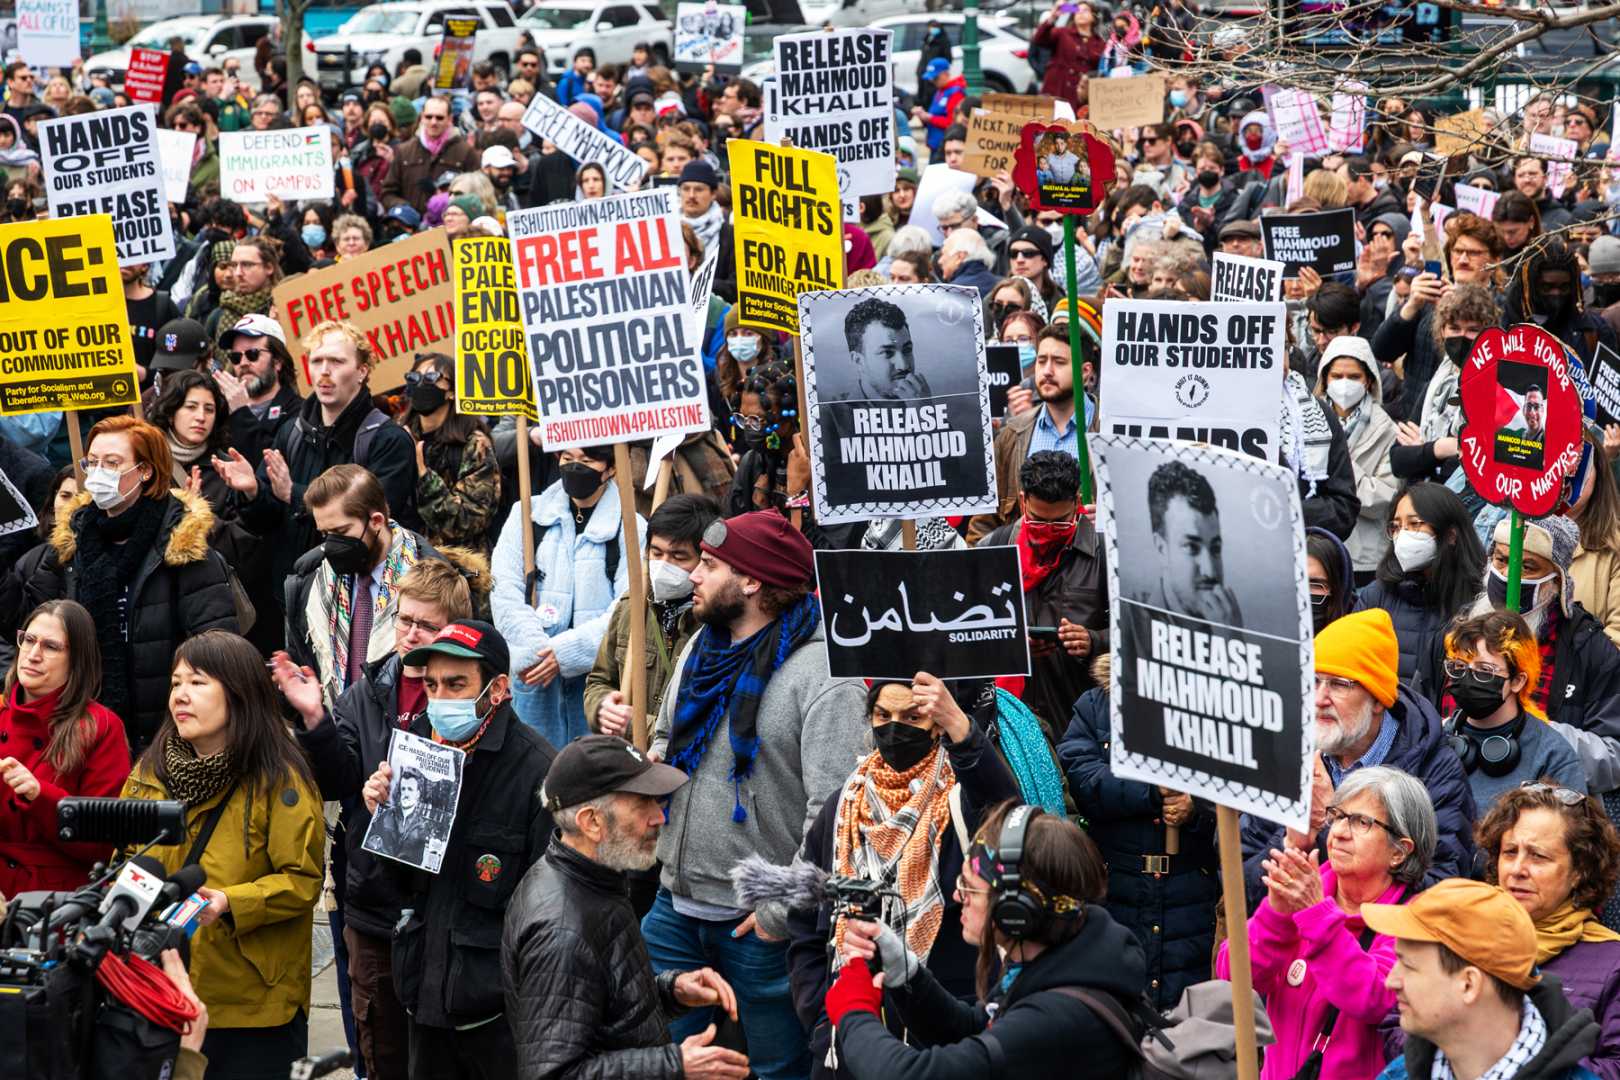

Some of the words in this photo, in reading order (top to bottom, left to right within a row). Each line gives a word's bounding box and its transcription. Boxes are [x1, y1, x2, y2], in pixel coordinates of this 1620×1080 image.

[780, 34, 888, 72] RELEASE
[781, 65, 887, 98] MAHMOUD
[782, 92, 888, 117] KHALIL
[46, 111, 150, 156] HANDS
[243, 133, 303, 150] DEFEND
[524, 96, 574, 144] FREE
[564, 124, 643, 186] MAHMOUD
[785, 121, 852, 149] HANDS
[858, 116, 889, 142] OFF
[53, 143, 150, 172] OFF
[226, 151, 326, 171] IMMIGRANTS
[754, 148, 817, 196] FULL
[983, 155, 1009, 170] FOR
[53, 173, 83, 191] OUR
[87, 161, 156, 186] STUDENTS
[232, 178, 255, 193] ON
[265, 173, 321, 191] CAMPUS
[513, 192, 672, 237] #SHUTITDOWN4PALESTINE
[739, 183, 834, 236] RIGHTS
[113, 216, 163, 244] MOUD
[1270, 226, 1300, 238] FREE
[1272, 234, 1340, 250] MAHMOUD
[116, 239, 167, 259] LIL
[460, 241, 514, 264] STAN
[516, 227, 604, 289] FREE
[615, 217, 681, 275] ALL
[743, 239, 787, 277] FOR
[794, 251, 837, 287] ALL
[1274, 250, 1318, 262] KHALIL
[286, 282, 350, 338] FREE
[351, 247, 450, 312] SPEECH
[461, 265, 516, 290] PALE
[745, 269, 830, 299] IMMIGRA
[1215, 259, 1276, 302] RELEASE
[462, 290, 520, 324] END
[523, 270, 686, 326] PALESTINIAN
[44, 328, 71, 350] OF
[82, 323, 121, 346] OUR
[461, 328, 526, 351] OCCUP
[1116, 311, 1218, 344] HANDS
[1227, 315, 1276, 345] OFF
[530, 313, 694, 377] POLITICAL
[1115, 343, 1159, 366] OUR
[1166, 345, 1273, 369] STUDENTS
[1, 348, 123, 375] COMMUNITIES!
[1471, 339, 1493, 370] WE
[1501, 331, 1525, 355] WILL
[1534, 335, 1570, 392] HONOR
[1599, 360, 1620, 388] FREE
[5, 387, 27, 397] Party
[28, 385, 39, 394] for
[41, 383, 77, 393] Socialism
[78, 381, 94, 390] and
[537, 359, 700, 417] PRISONERS
[987, 371, 1010, 385] OUD
[1594, 373, 1620, 406] MAHM
[7, 395, 48, 406] Liberation
[547, 404, 705, 445] #SHUTITDOWN4PALESTINE
[852, 403, 949, 435] RELEASE
[840, 430, 967, 464] MAHMOUD
[866, 461, 946, 491] KHALIL
[1463, 436, 1487, 477] ALL
[1496, 472, 1523, 499] OUR
[1530, 442, 1579, 501] MARTYRS
[830, 580, 1018, 647] تضامن
[948, 628, 1018, 643] SOLIDARITY
[1151, 619, 1264, 686] RELEASE
[1136, 658, 1284, 733] MAHMOUD
[1163, 707, 1259, 770] KHALIL
[427, 752, 438, 760] OFF
